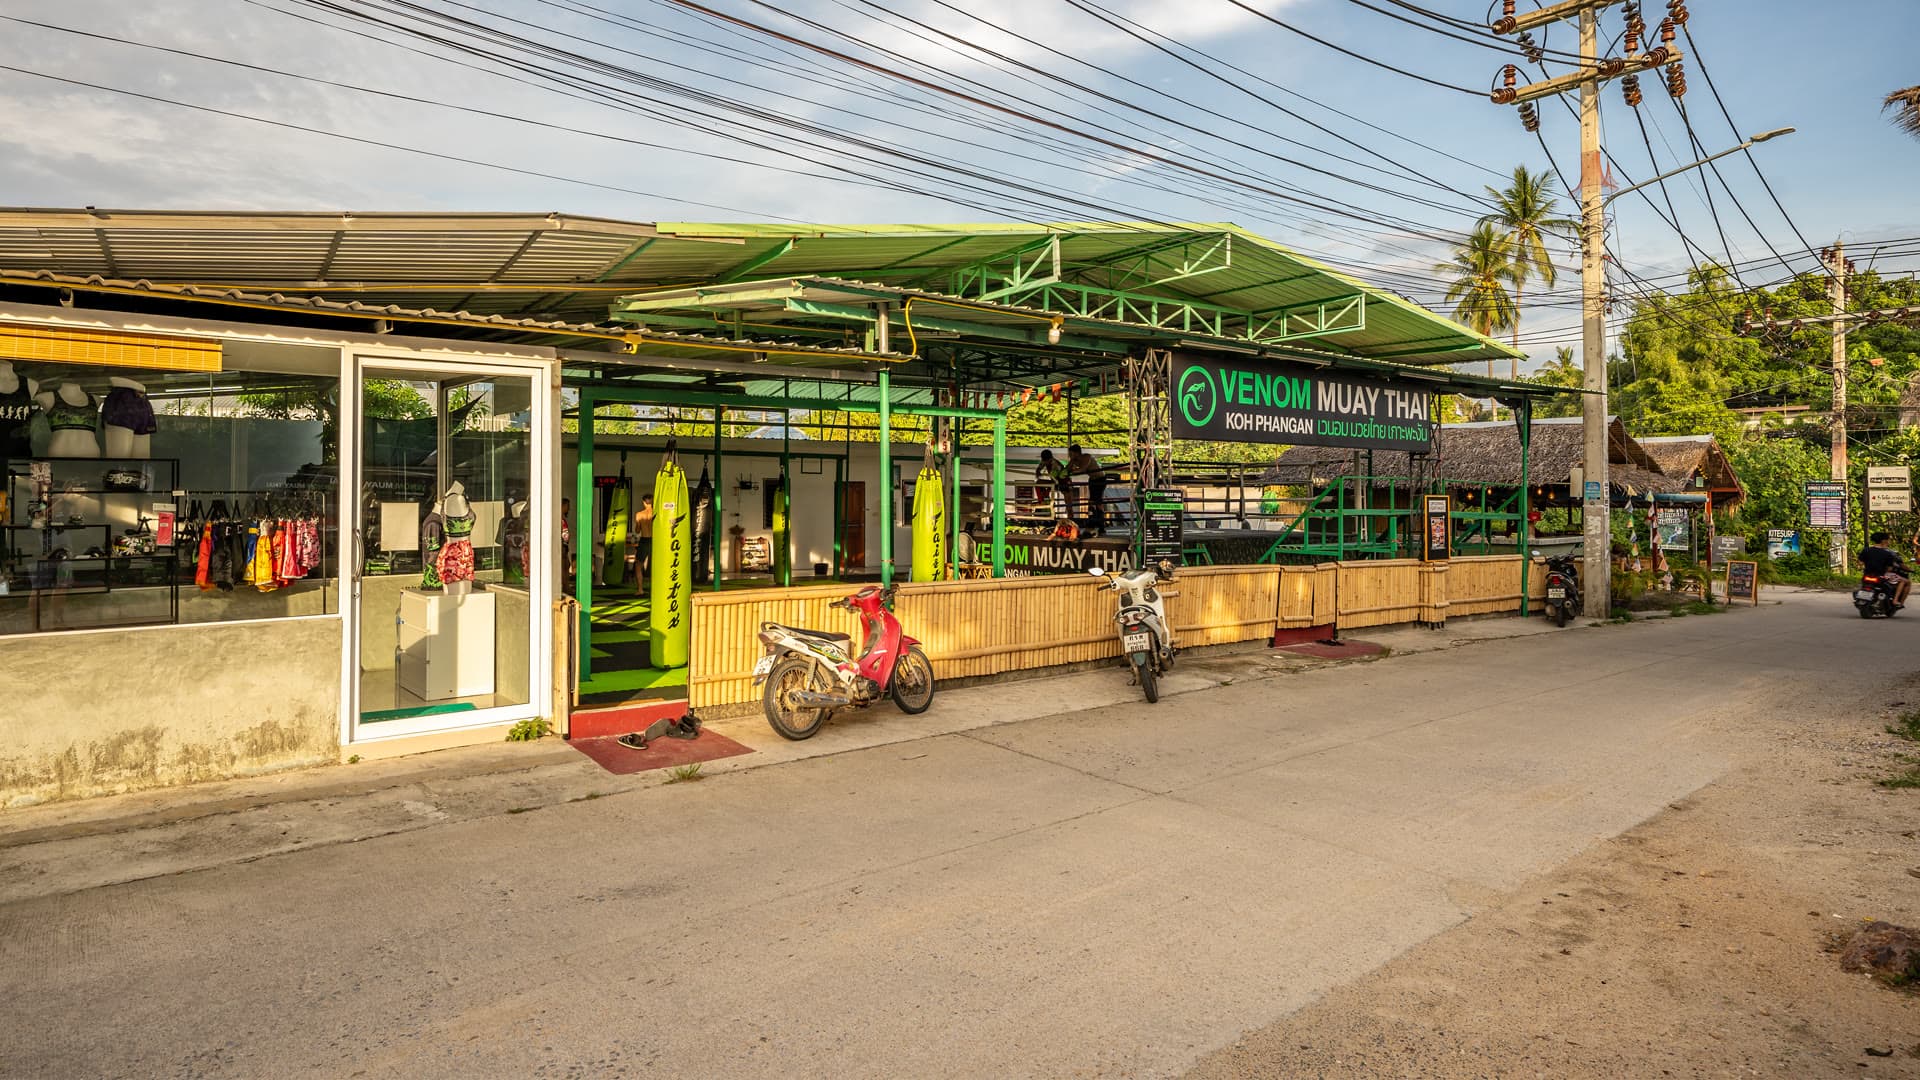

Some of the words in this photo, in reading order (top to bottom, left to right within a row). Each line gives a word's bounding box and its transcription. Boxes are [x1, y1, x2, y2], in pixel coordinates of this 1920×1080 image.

[1219, 368, 1311, 410] VENOM
[1317, 380, 1380, 416] MUAY
[1384, 389, 1428, 421] THAI
[1225, 411, 1252, 431] KOH
[1255, 414, 1313, 435] PHANGAN
[1351, 418, 1386, 439] มวยไทย
[1033, 545, 1087, 569] MUAY
